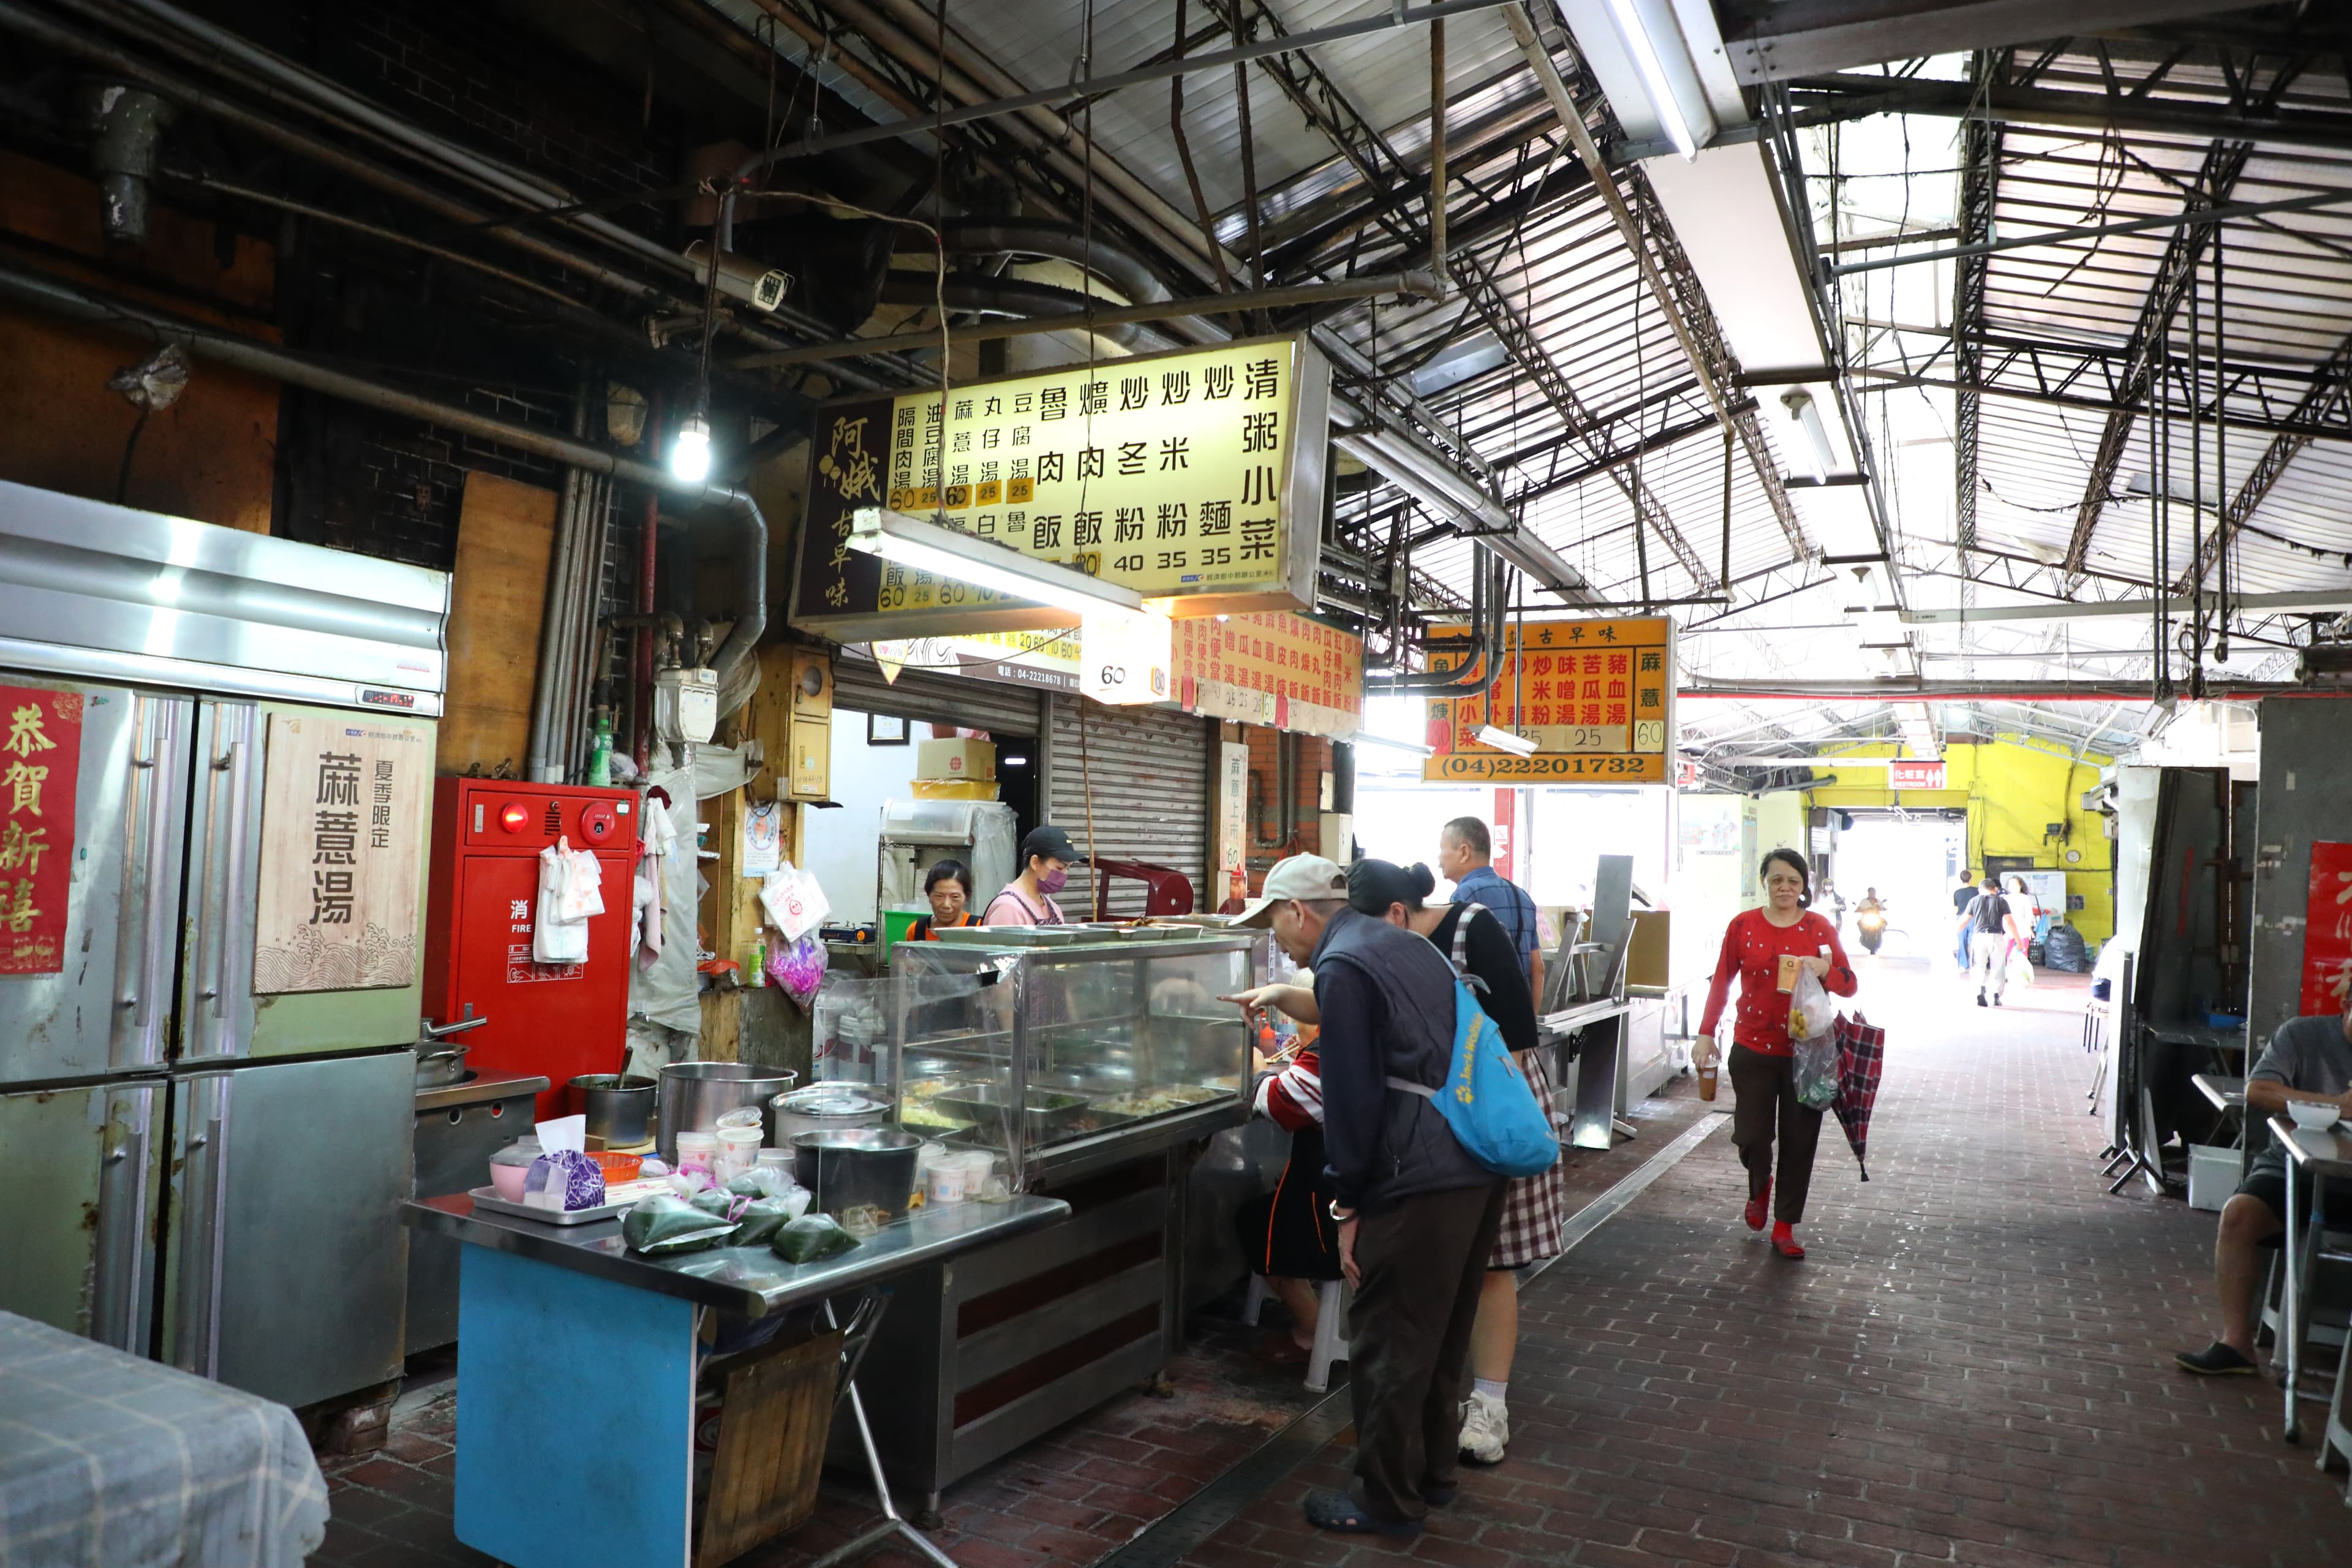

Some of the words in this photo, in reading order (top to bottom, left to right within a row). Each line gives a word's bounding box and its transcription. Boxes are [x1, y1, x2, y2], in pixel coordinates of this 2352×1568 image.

[921, 402, 941, 488] 油豆腐湯
[979, 396, 1003, 483] 丸仔湯
[1010, 393, 1033, 480] 豆腐湯
[894, 407, 916, 489] 隔間肉湯
[1156, 370, 1191, 540] 炒米粉
[1199, 364, 1234, 537] 炒麵
[1240, 358, 1279, 560] 清粥小菜
[1033, 386, 1068, 549] 魯肉飯
[1114, 376, 1149, 543] 炒冬粉
[890, 489, 914, 510] 60
[922, 491, 937, 504] 25
[946, 487, 967, 507] 60
[981, 484, 997, 499] 25
[1012, 483, 1028, 497] 25
[1114, 554, 1144, 571] 40
[1157, 551, 1187, 569] 35
[1201, 548, 1231, 566] 35
[880, 587, 904, 608] 60
[914, 591, 929, 602] 25
[940, 583, 965, 605] 60
[1020, 633, 1031, 649] 20
[1101, 665, 1126, 685] 60
[1531, 655, 1552, 725] 炒米粉
[1556, 655, 1577, 725] 味噌湯
[1580, 654, 1602, 725] 苦瓜湯
[1606, 654, 1627, 725] 豬血湯
[1264, 694, 1275, 716] 60
[1575, 729, 1601, 746] 25
[1638, 722, 1662, 745] 60
[1442, 758, 1645, 778] (04)22201732
[371, 760, 393, 848] 夏季限定
[0, 702, 58, 933] 恭賀新禧
[510, 900, 529, 919] 消
[511, 924, 532, 933] FIRE
